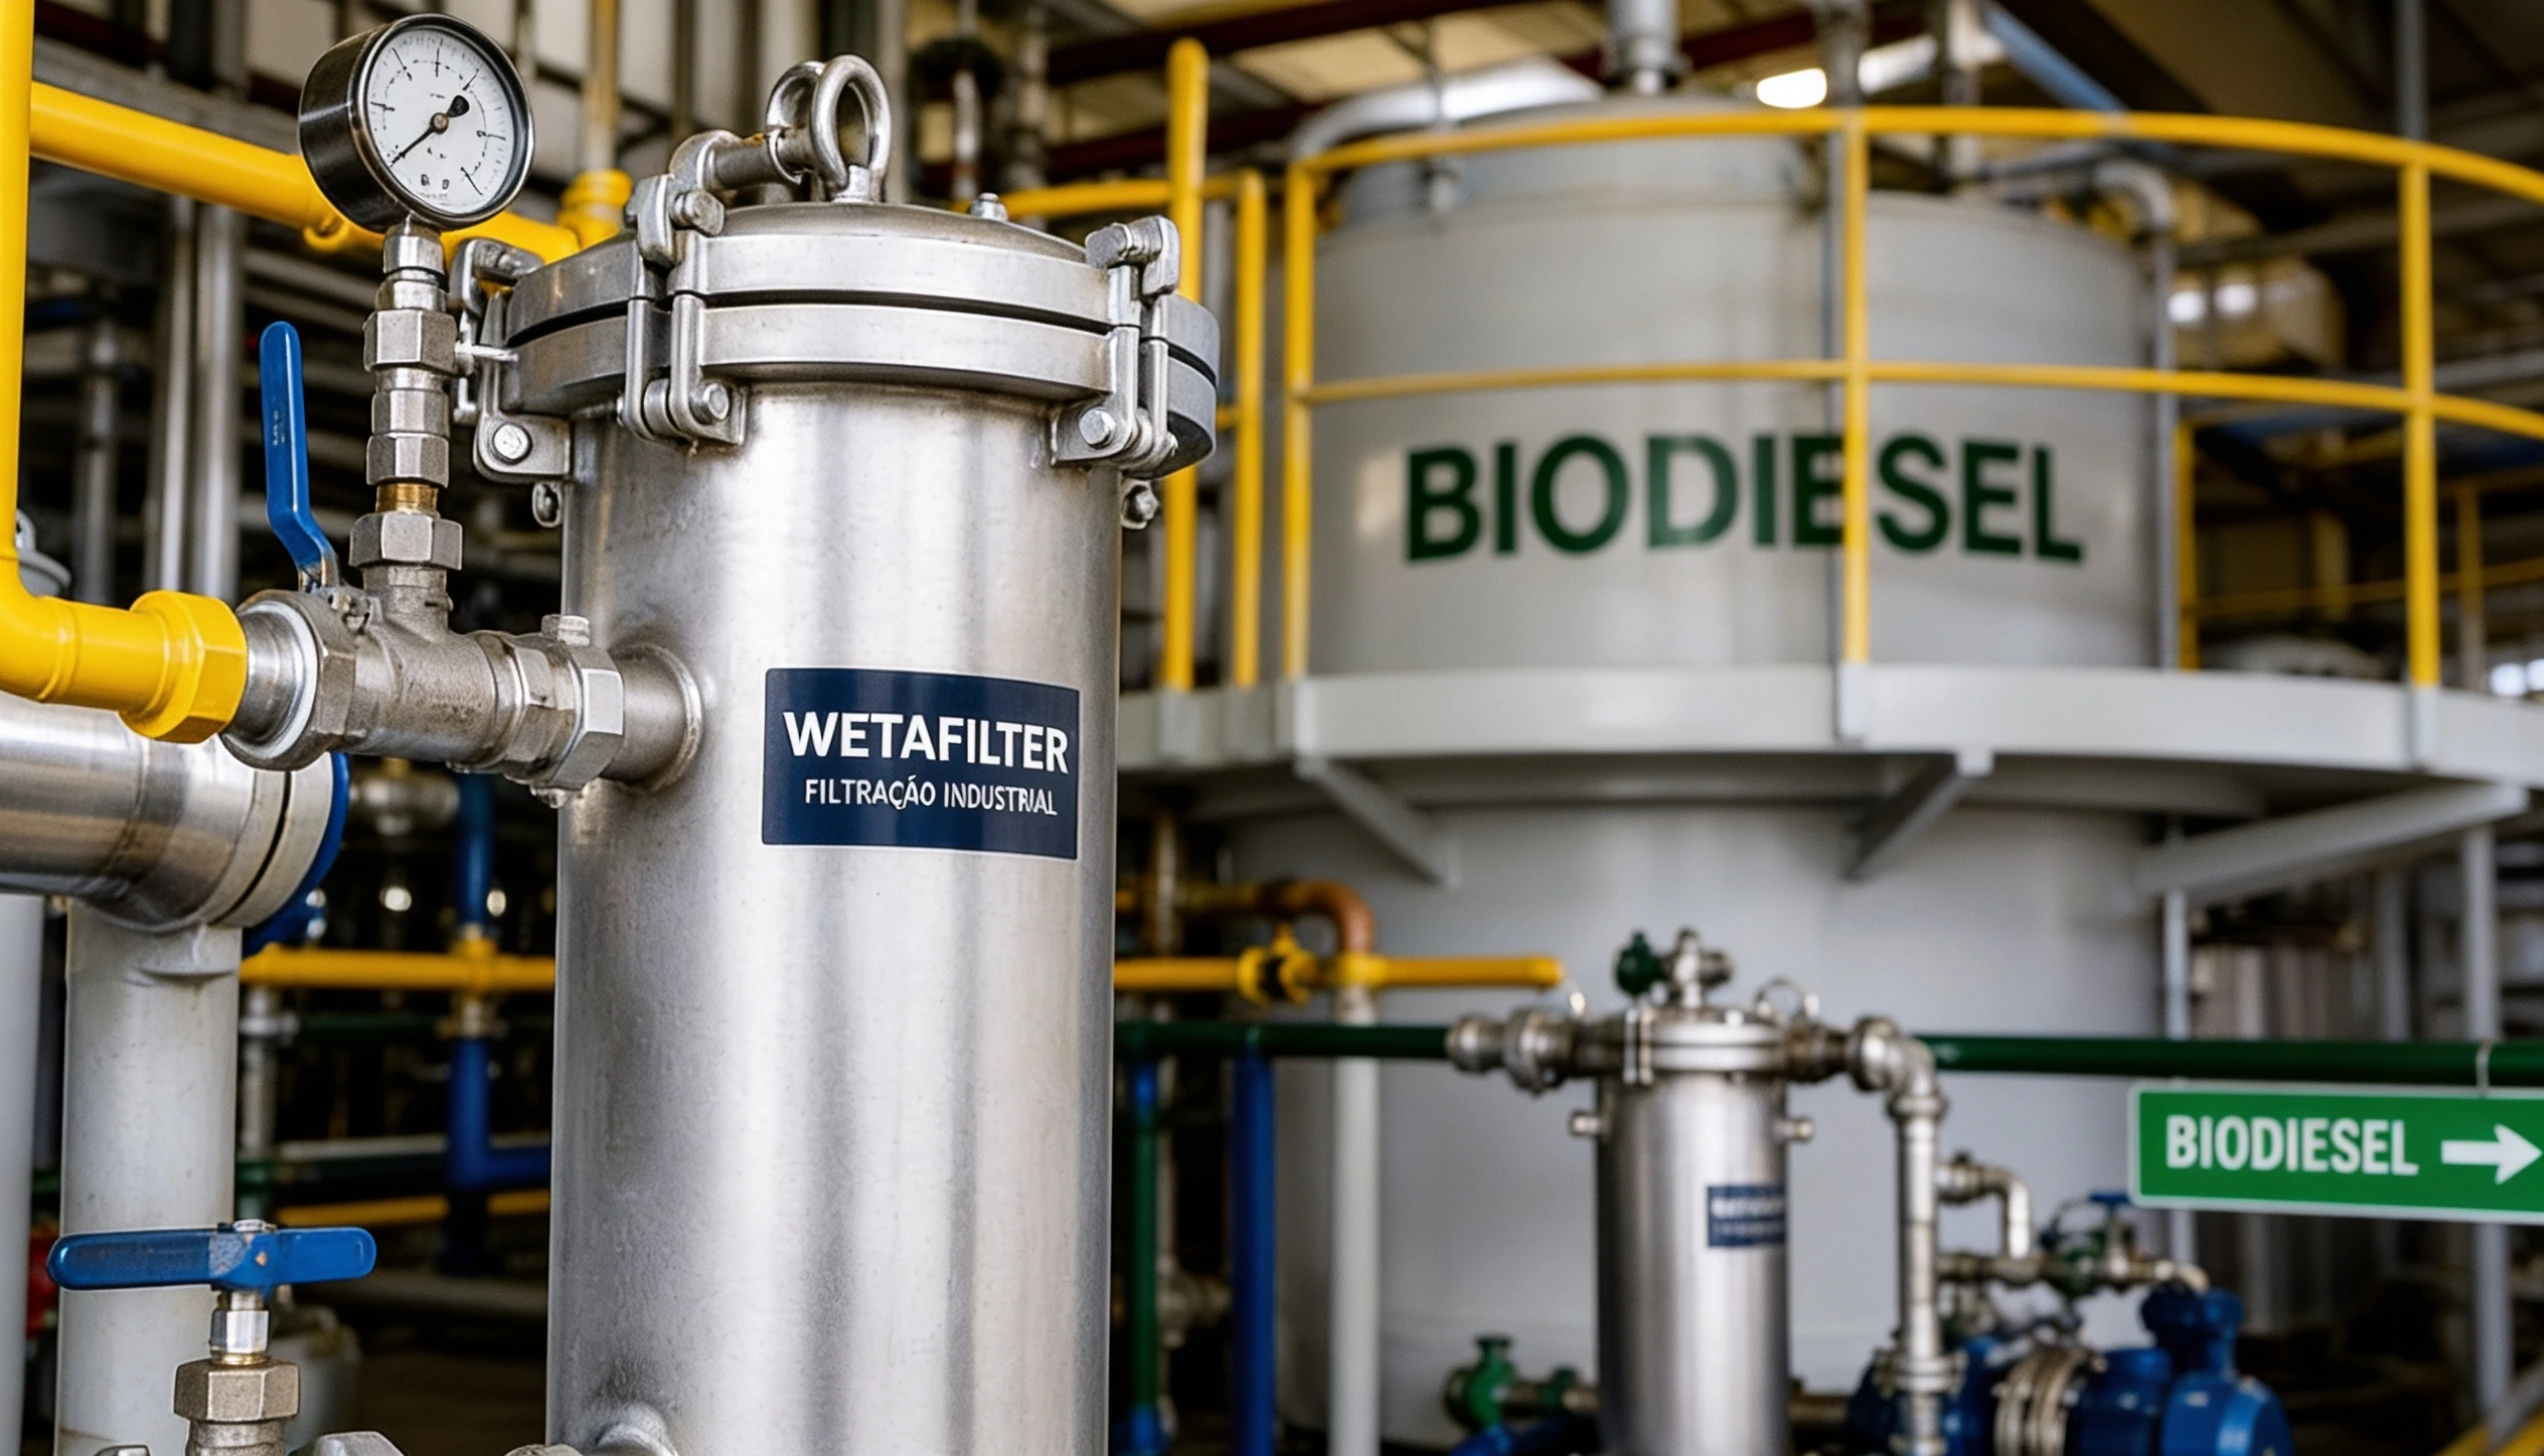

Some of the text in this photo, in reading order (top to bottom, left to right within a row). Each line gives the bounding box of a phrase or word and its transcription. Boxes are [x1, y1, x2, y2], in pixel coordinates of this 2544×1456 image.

[1406, 433, 2086, 565] BIODIESEL
[783, 711, 1069, 774] WETAFILTER
[943, 781, 1058, 816] INDUSTRIAL
[2166, 1114, 2420, 1177] BIODIESEL
